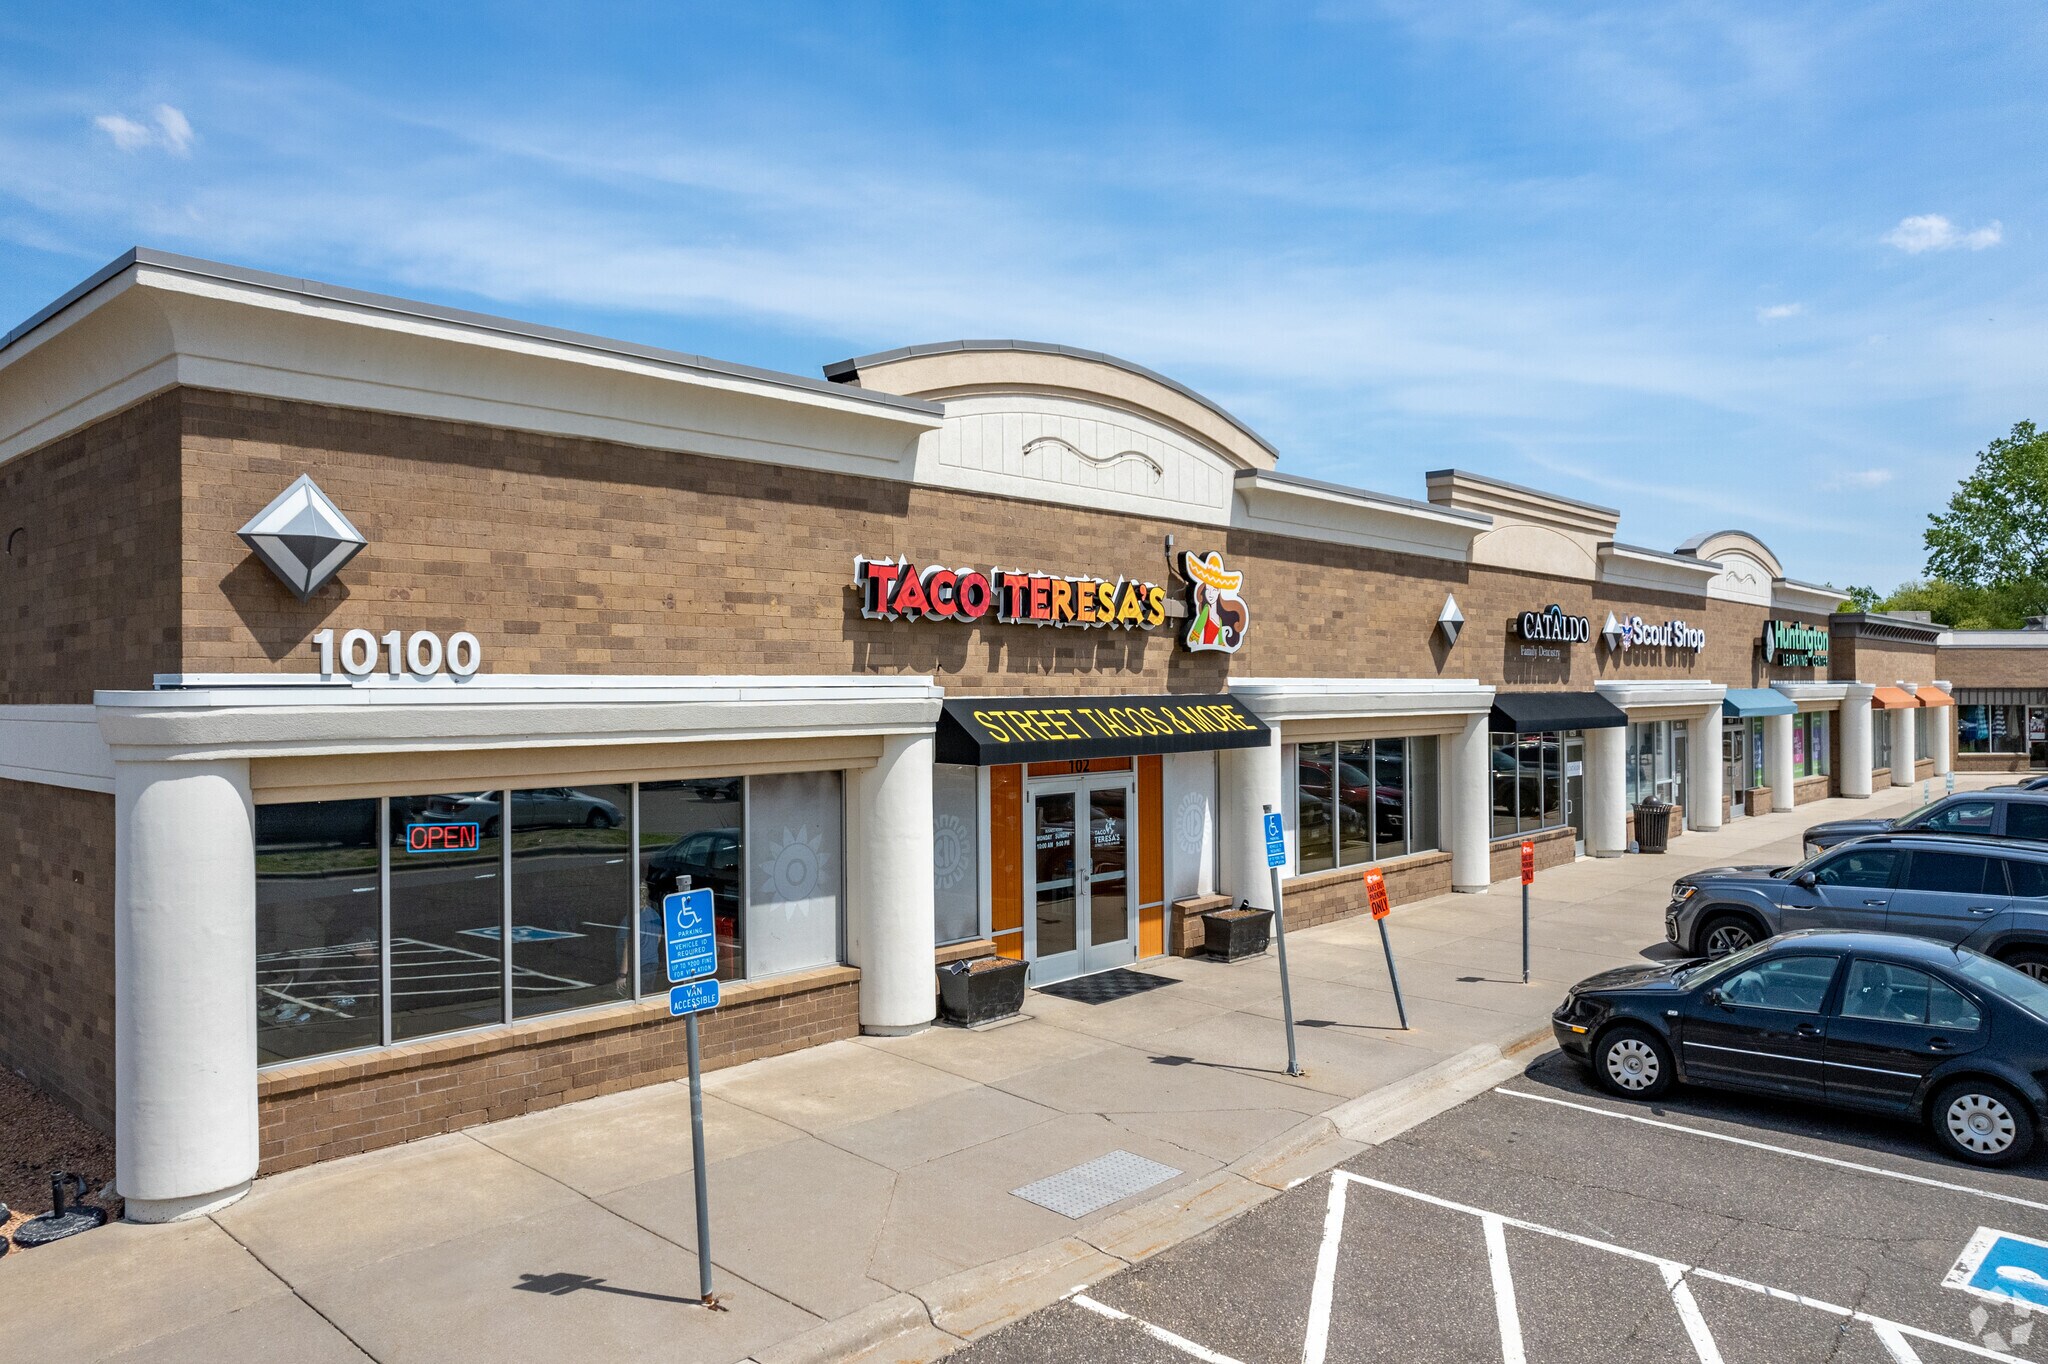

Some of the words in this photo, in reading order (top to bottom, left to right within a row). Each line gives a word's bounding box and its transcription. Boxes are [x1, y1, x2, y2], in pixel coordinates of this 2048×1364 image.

[862, 560, 991, 618] TACO
[1000, 571, 1166, 627] TERESA'S
[1524, 612, 1590, 642] CATALDO
[1632, 616, 1672, 646] Scout
[1674, 620, 1705, 654] Shop
[1775, 620, 1829, 658] Huntington
[312, 628, 481, 676] 10100
[1520, 645, 1538, 659] Family
[1783, 654, 1808, 667] LEARNING
[973, 708, 1082, 743] STREET
[1077, 706, 1172, 738] TACOS
[1163, 706, 1194, 735] &
[1178, 704, 1258, 732] MORE
[1068, 759, 1090, 774] 102
[411, 826, 475, 849] OPEN
[1094, 833, 1120, 844] TERESA'S
[1369, 889, 1386, 902] PARKING
[1371, 896, 1388, 915] ONLY
[677, 927, 703, 937] PARKING
[675, 940, 699, 951] VEHICLE
[701, 938, 708, 948] ID
[677, 946, 706, 957] REQUIRED
[671, 964, 679, 972] UP
[680, 962, 687, 970] TO
[701, 957, 713, 965] FINE
[673, 970, 684, 978] FOR
[685, 965, 712, 976] VILATION
[686, 987, 703, 998] VAN
[673, 993, 716, 1011] ACCESSIBLE
